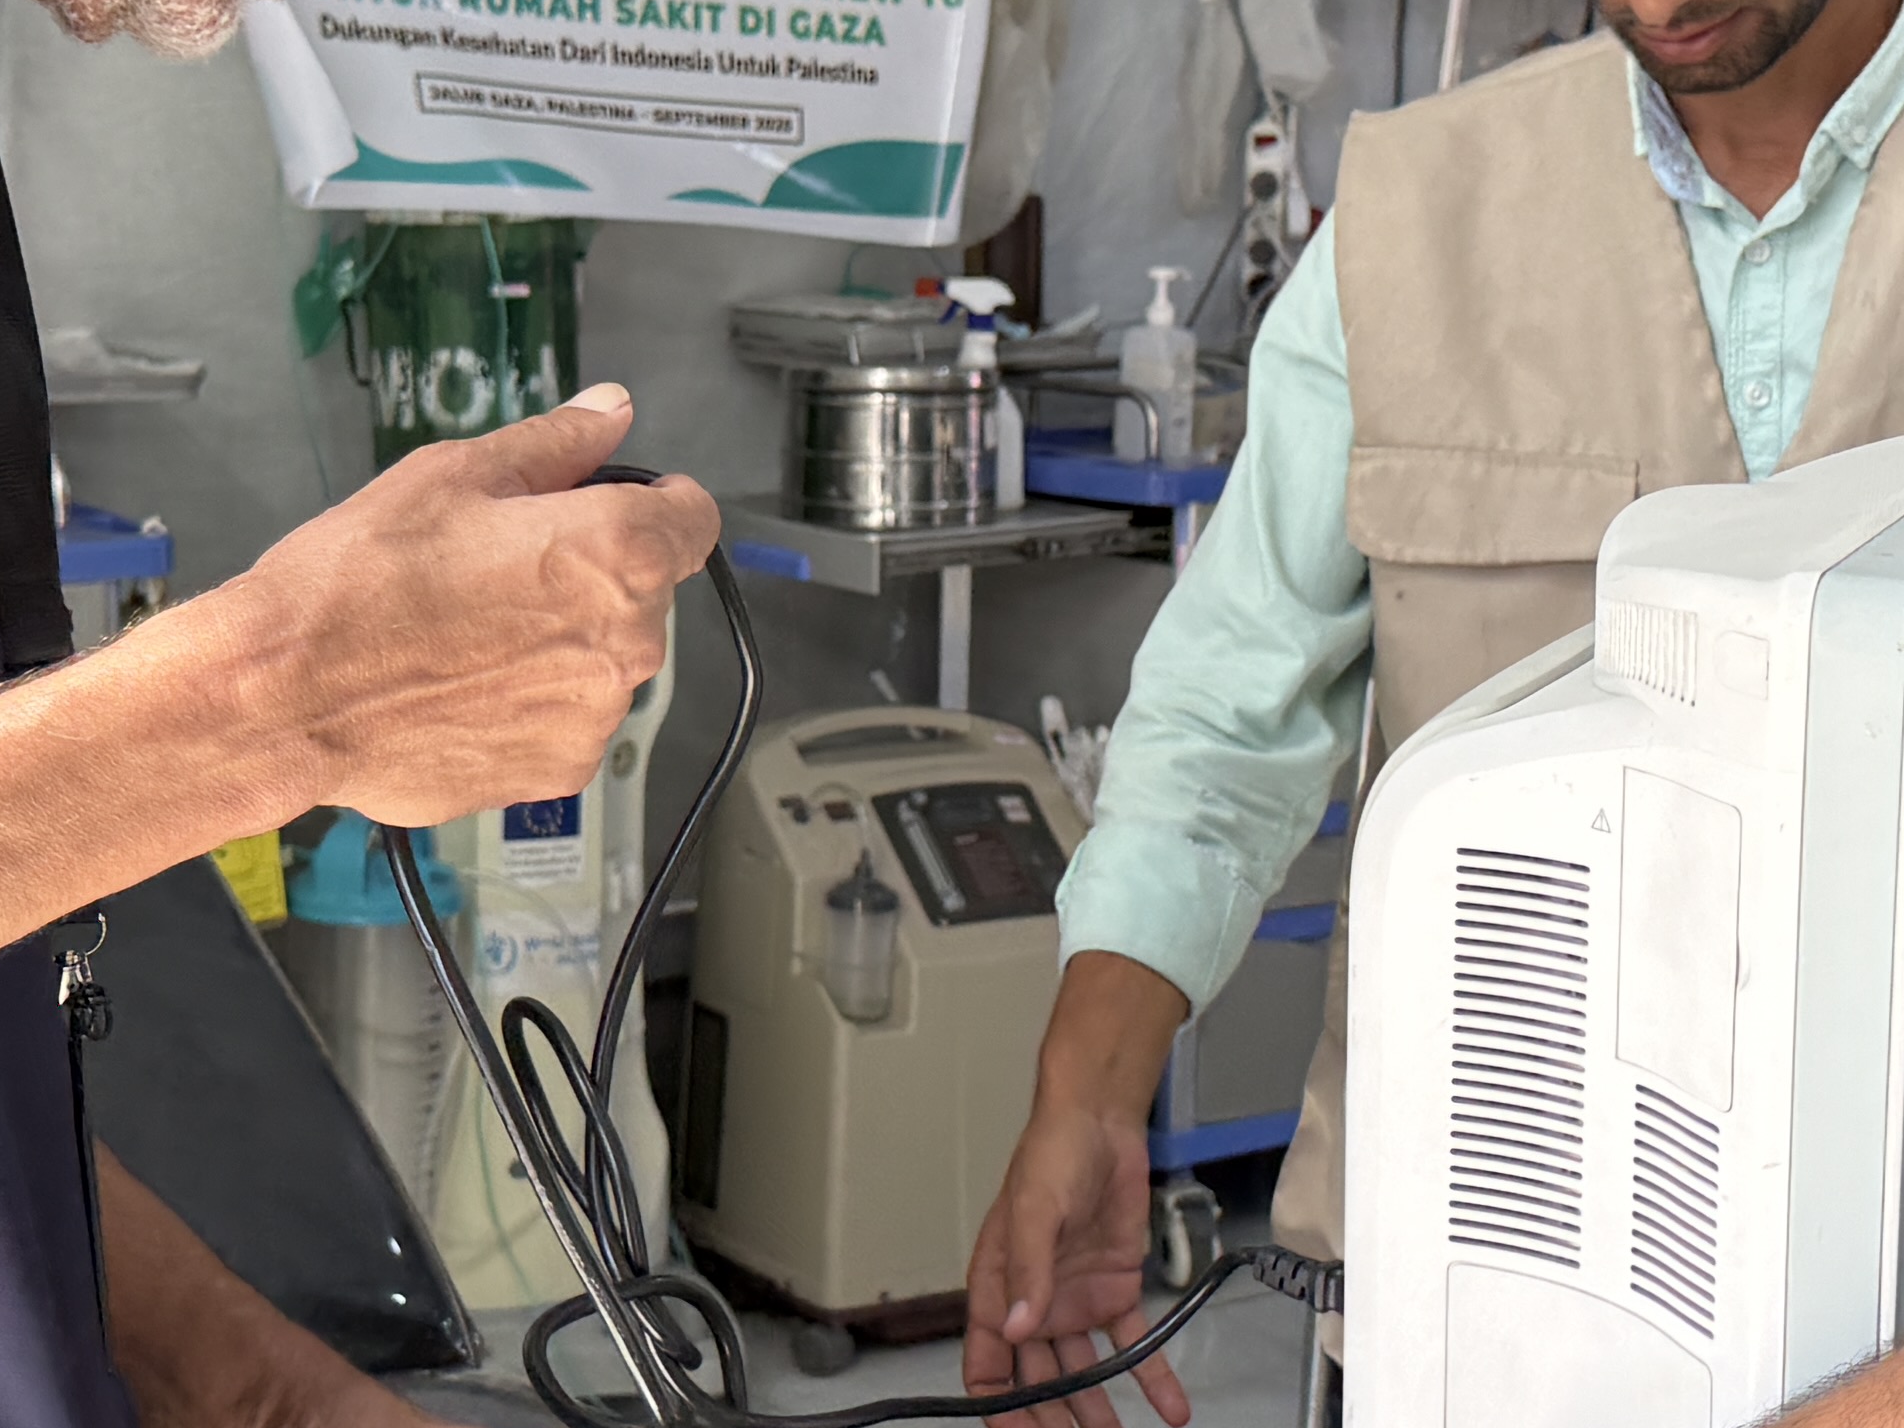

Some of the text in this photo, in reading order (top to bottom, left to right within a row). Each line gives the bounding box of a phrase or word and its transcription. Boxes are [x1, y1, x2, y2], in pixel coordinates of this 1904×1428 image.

[738, 5, 777, 37] DI
[788, 9, 887, 47] GAZA
[318, 12, 880, 85] Dukungan Kesehatan Dari Indonesia Untuk Palestina
[546, 97, 637, 121] PALESTINA
[653, 107, 751, 130] SEPTEMBER
